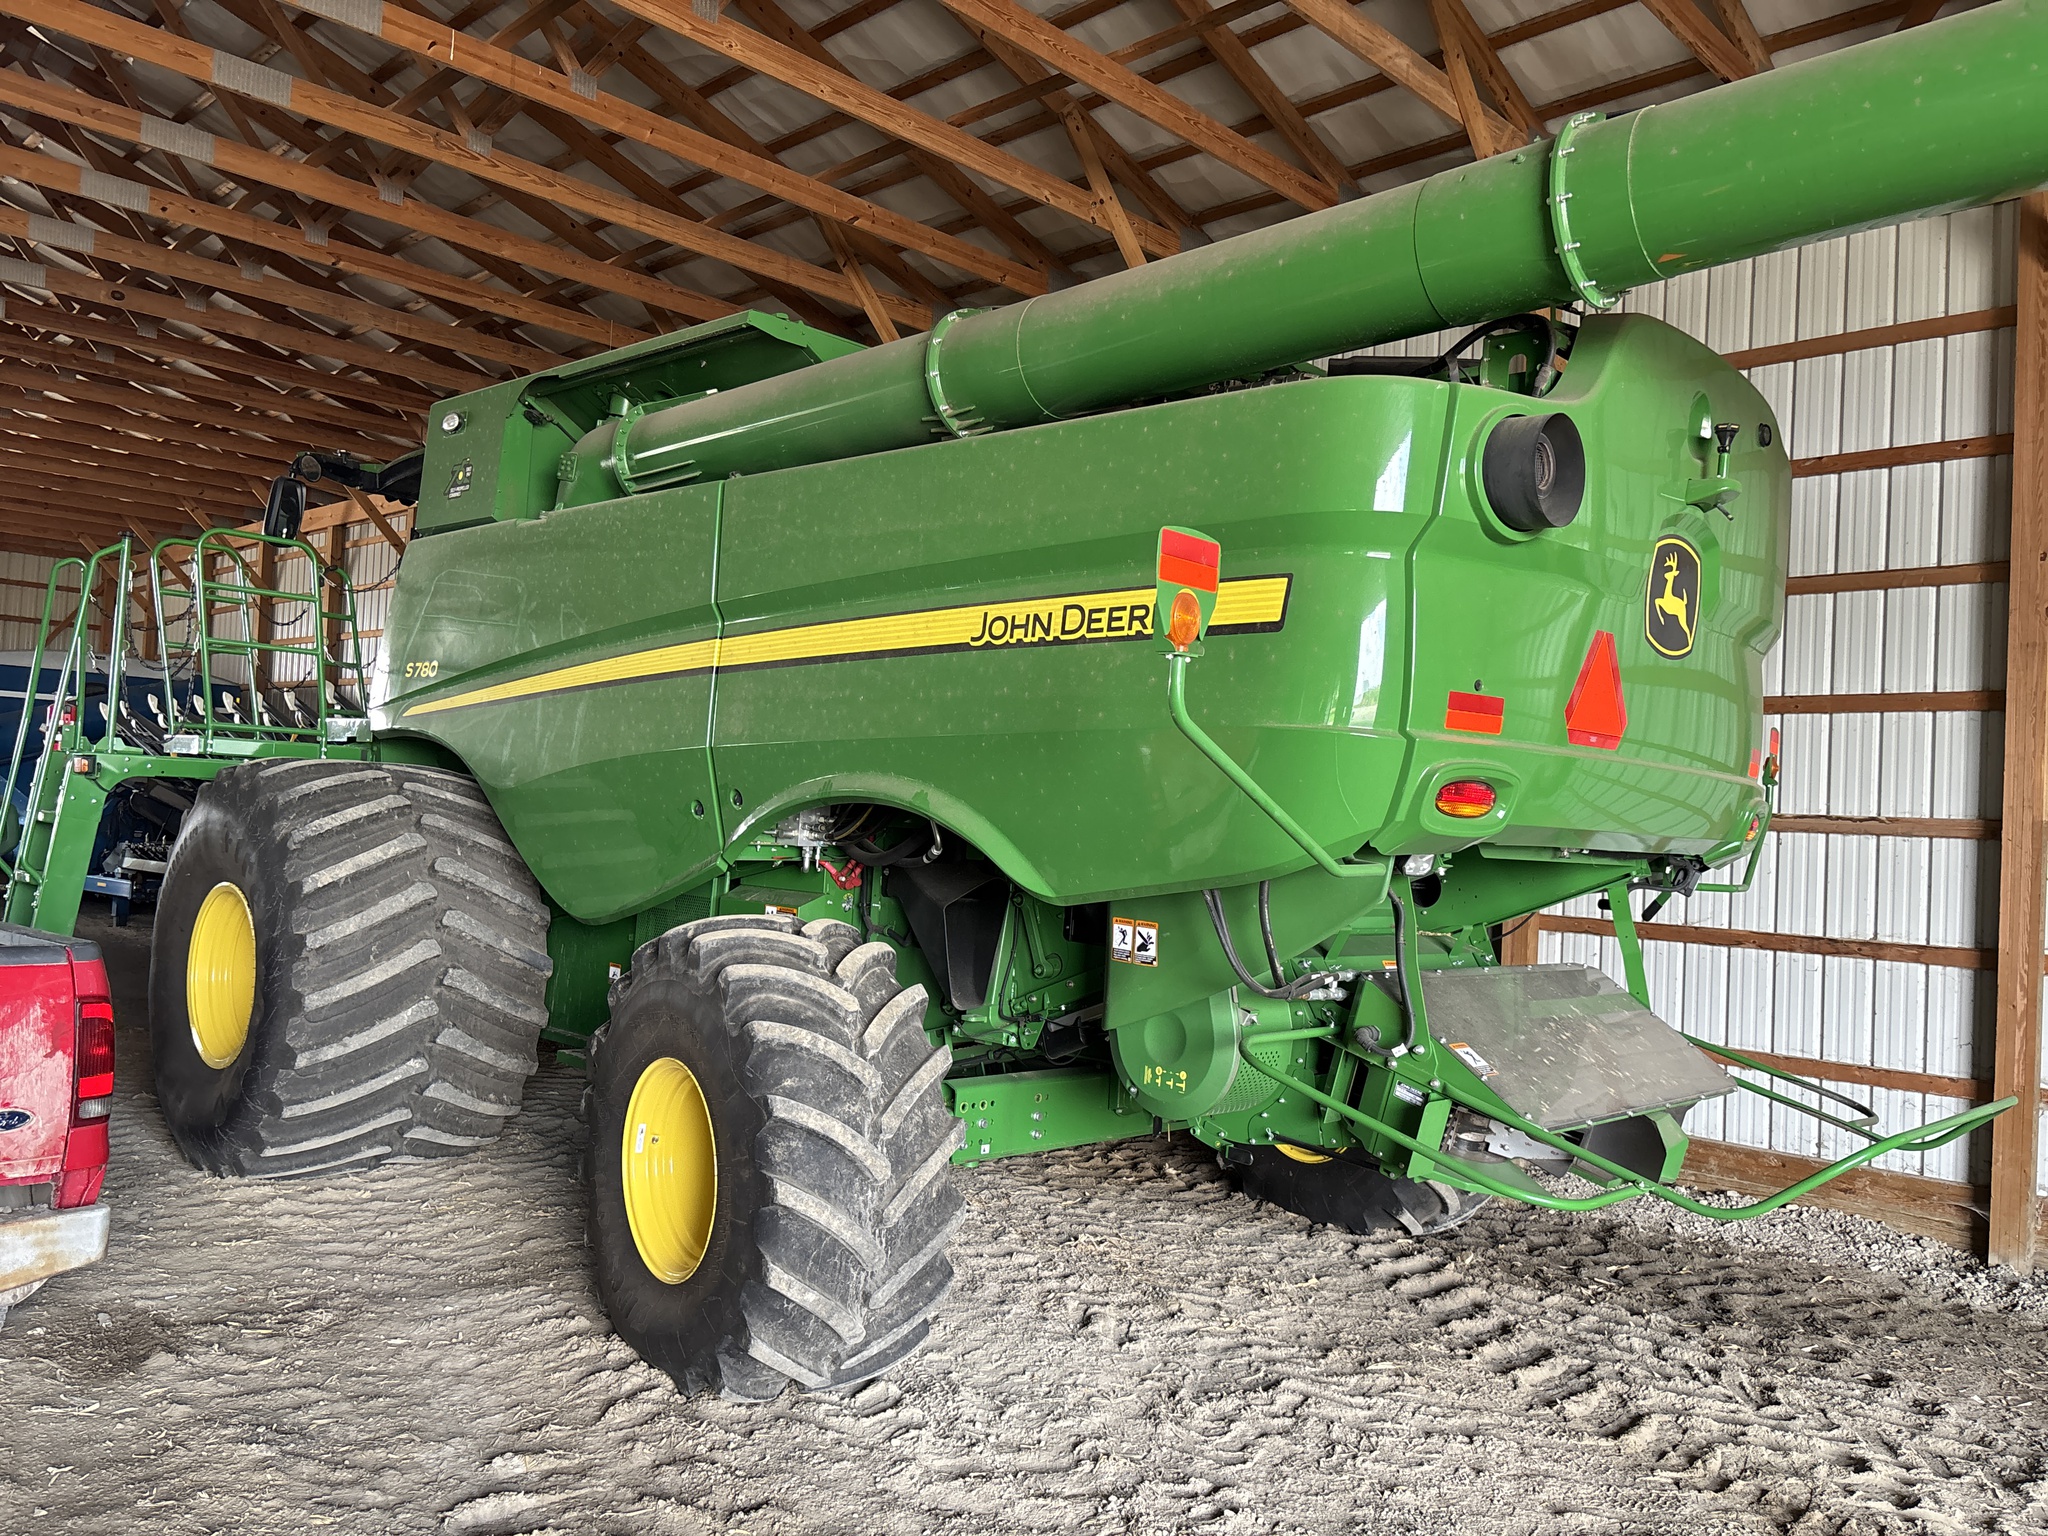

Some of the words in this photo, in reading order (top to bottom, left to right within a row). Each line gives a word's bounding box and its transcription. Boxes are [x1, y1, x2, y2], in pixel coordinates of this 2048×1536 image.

[970, 611, 1053, 642] JOHN
[1060, 604, 1156, 636] DEER
[404, 659, 439, 678] S780
